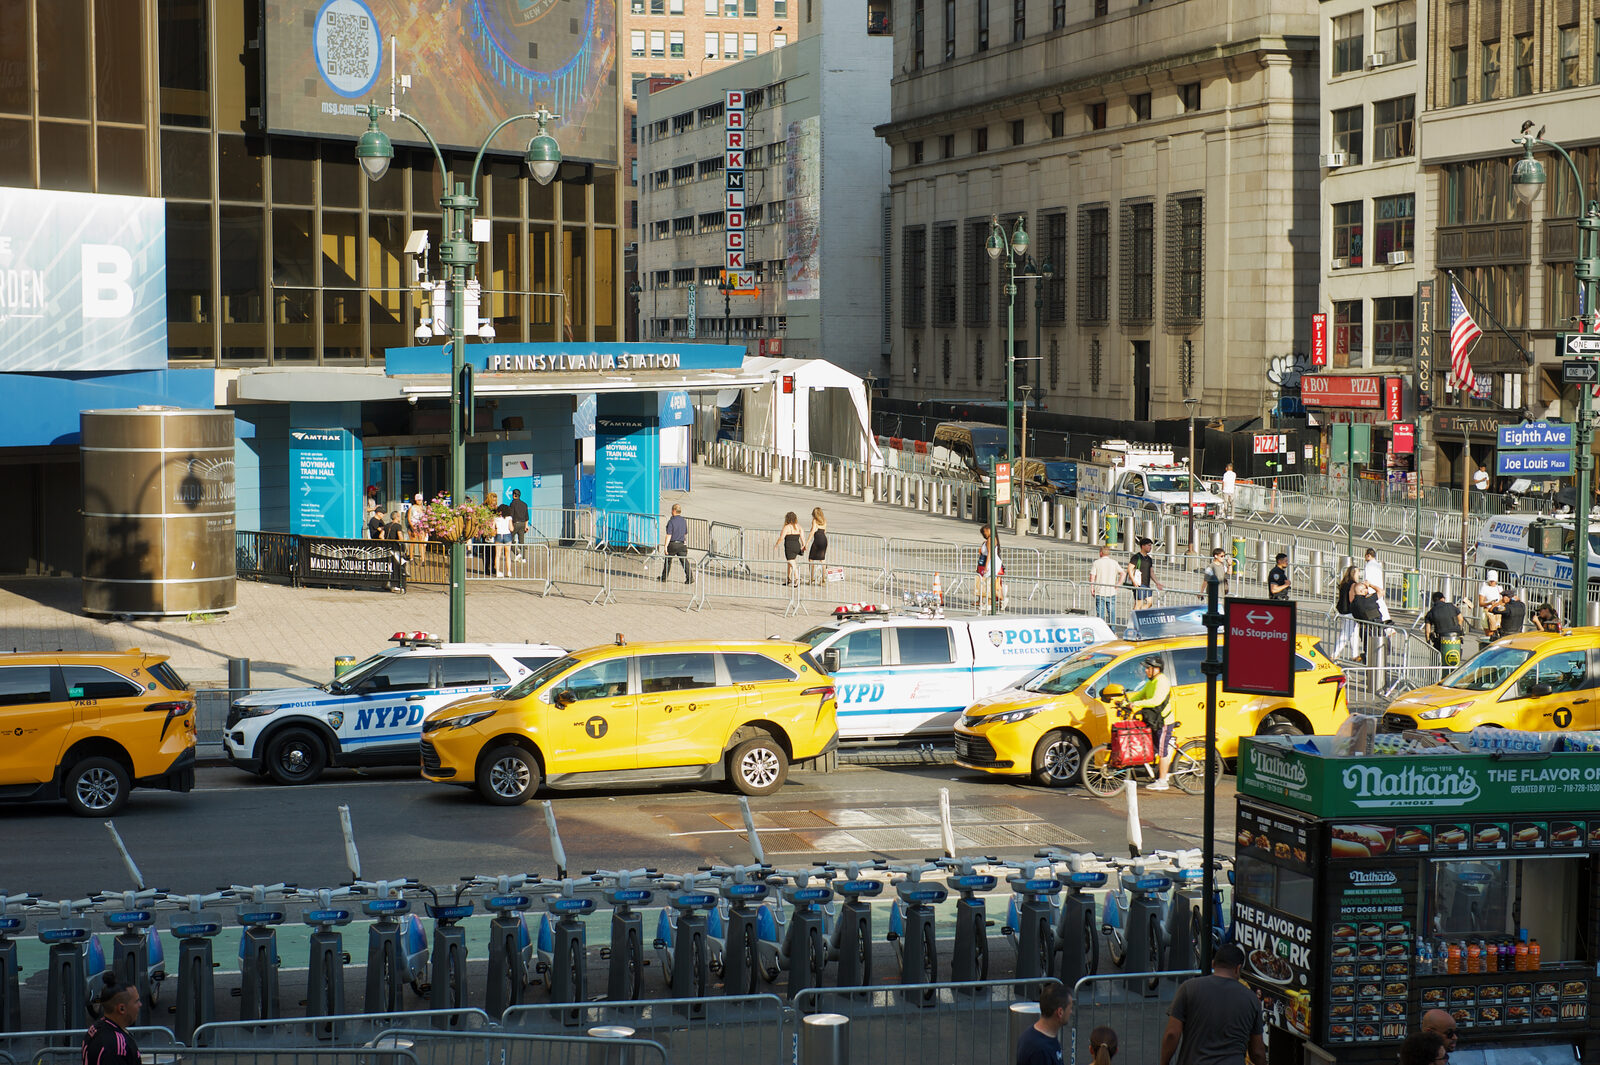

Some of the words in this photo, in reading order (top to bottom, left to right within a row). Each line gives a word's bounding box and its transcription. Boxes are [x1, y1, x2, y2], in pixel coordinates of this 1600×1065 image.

[523, 6, 542, 21] NEW
[729, 93, 742, 167] PARK
[729, 193, 742, 267] LOCK
[81, 243, 134, 318] B
[1313, 315, 1325, 323] 99¢
[1315, 323, 1323, 364] PIZZA
[1421, 336, 1430, 356] NA
[1573, 340, 1588, 349] ONE
[494, 354, 615, 371] PENNSYLVANIA
[623, 353, 681, 369] STATION
[1568, 368, 1579, 376] ONE
[1582, 367, 1593, 377] WAY
[1303, 378, 1309, 392] 4
[1310, 378, 1329, 393] BOY
[1350, 378, 1378, 394] PIZZA
[1391, 386, 1399, 420] PIZZA
[1480, 416, 1498, 432] NÓG
[1255, 436, 1278, 453] PIZZA
[1505, 430, 1541, 445] Eighth
[1544, 430, 1566, 442] Ave
[300, 461, 335, 469] MOYNIHAN
[1505, 458, 1522, 470] Joe
[1523, 457, 1548, 469] Louis
[300, 468, 318, 476] TRAIN
[173, 484, 218, 501] MADISON
[1495, 522, 1524, 537] POLICE
[310, 557, 340, 570] MADISON
[341, 558, 366, 571] SQUARE
[367, 559, 393, 573] GARDEN
[1554, 564, 1573, 581] NYP
[1005, 628, 1080, 645] POLICE
[1231, 627, 1244, 636] No
[1246, 627, 1288, 642] Stopping
[1003, 646, 1051, 655] EMERGENCY
[837, 683, 885, 703] NYPD
[354, 704, 425, 731] NYPD
[1556, 711, 1569, 726] T
[590, 720, 603, 737] T
[1250, 748, 1306, 783] Nathan's
[1421, 765, 1438, 773] Since
[1342, 764, 1477, 798] Nathan's
[1488, 769, 1517, 782] THE
[1521, 769, 1580, 782] FLAVOR
[1511, 785, 1538, 794] OPERATED
[1538, 785, 1546, 793] BY
[1563, 784, 1600, 792] 718-728-1530
[1349, 870, 1396, 883] Nathan's
[1341, 897, 1370, 906] WORLD
[1235, 902, 1254, 923] THE
[1255, 909, 1295, 939] FLAVOR
[1296, 926, 1312, 943] OF
[1234, 920, 1267, 951] NEW
